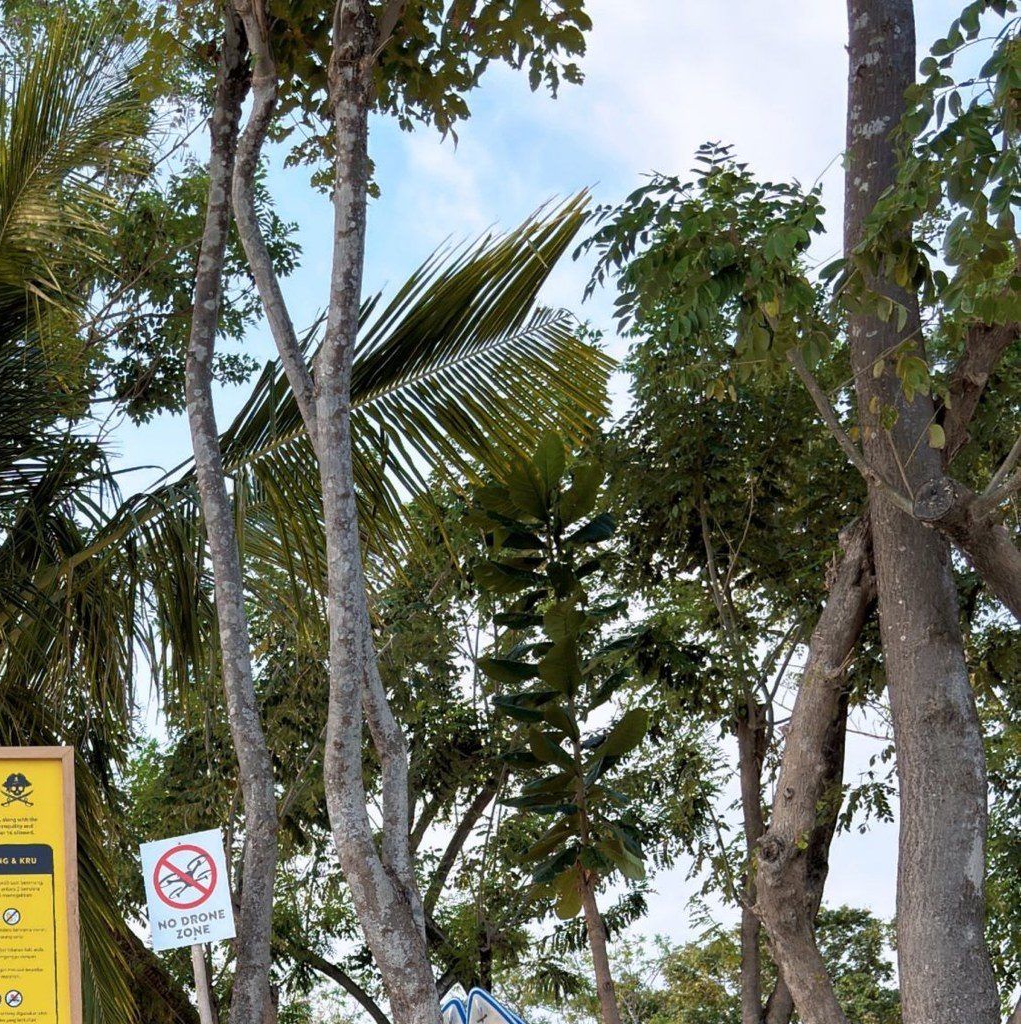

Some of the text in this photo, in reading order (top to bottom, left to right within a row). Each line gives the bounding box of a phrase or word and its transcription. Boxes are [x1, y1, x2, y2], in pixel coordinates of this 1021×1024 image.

[158, 909, 226, 931] NO DRONE
[176, 925, 210, 940] ZONE
